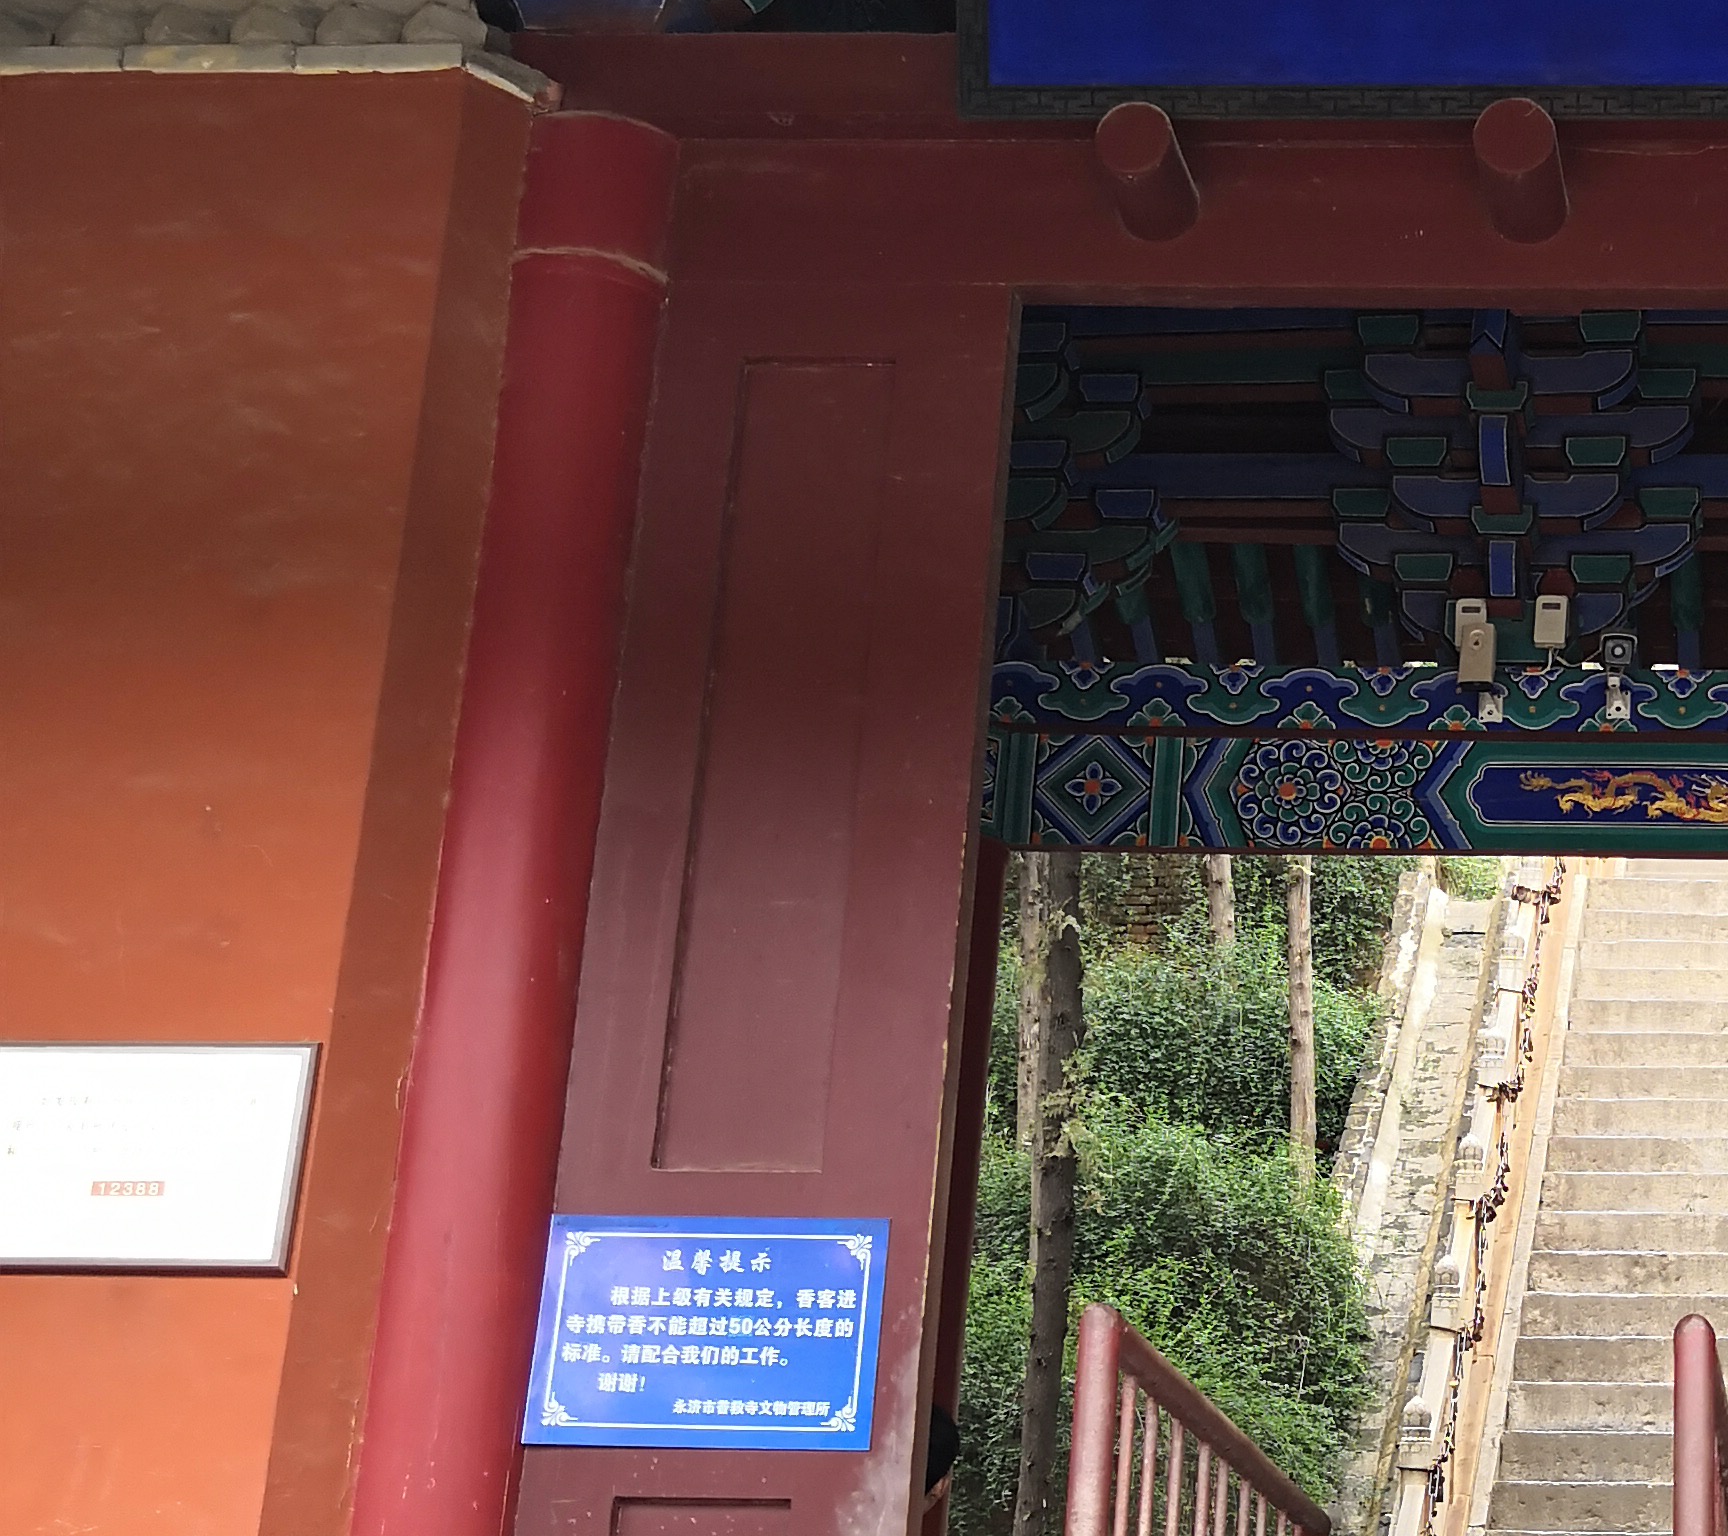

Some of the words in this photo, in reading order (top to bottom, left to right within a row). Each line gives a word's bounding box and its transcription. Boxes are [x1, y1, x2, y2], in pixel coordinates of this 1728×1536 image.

[98, 1182, 160, 1196] 12388
[661, 1249, 773, 1276] 温馨提示
[565, 1314, 854, 1339] 寺携带香不能超过50公分长度的
[561, 1343, 790, 1368] 标准。请配合我们的工作。
